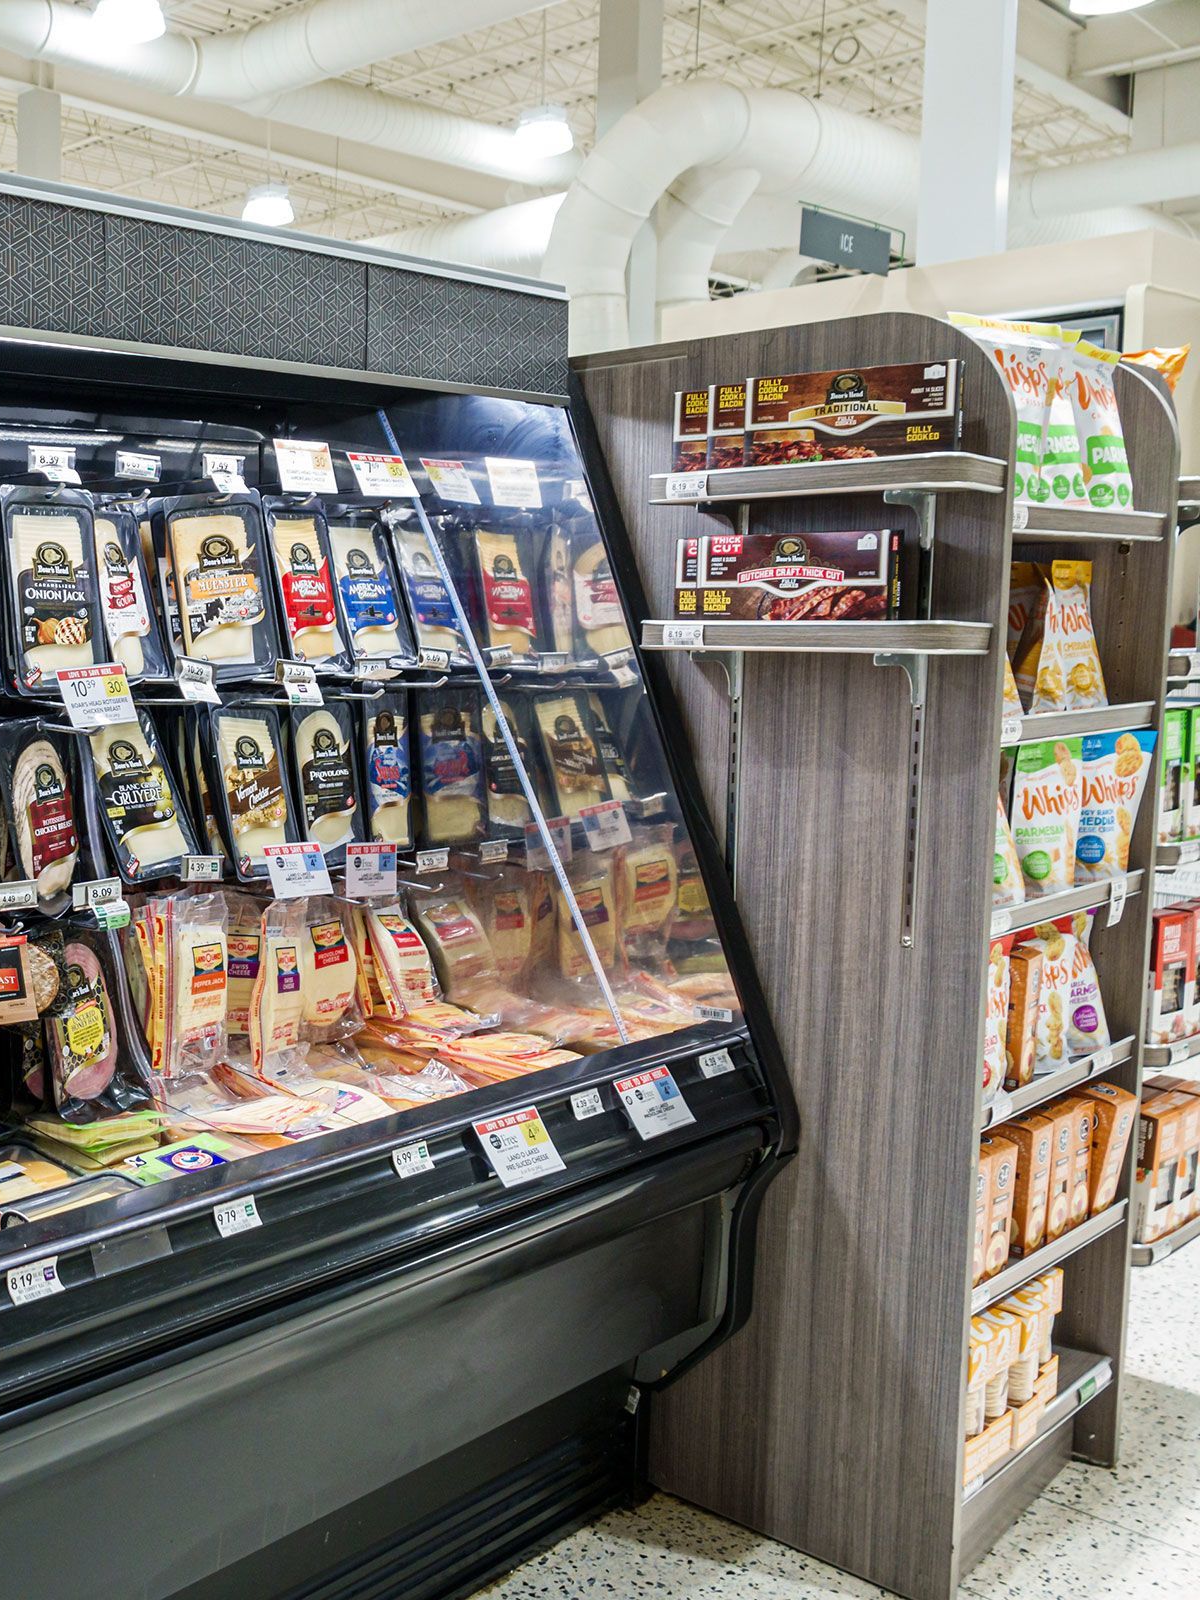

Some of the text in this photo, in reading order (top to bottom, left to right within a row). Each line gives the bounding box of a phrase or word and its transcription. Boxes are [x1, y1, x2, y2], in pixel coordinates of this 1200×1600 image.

[840, 233, 854, 253] ICE
[759, 379, 782, 387] FULLY
[758, 393, 783, 401] BACON
[814, 404, 878, 414] TRADITIONAL
[672, 482, 686, 491] 8.19
[713, 544, 741, 552] CUT
[740, 571, 774, 581] BUTCHER
[801, 569, 824, 578] THICK
[826, 572, 841, 581] CUT
[199, 577, 248, 591] MUENSTER
[291, 581, 326, 596] AMERICAN
[350, 584, 385, 596] AMERICAN
[25, 588, 85, 602] ONION JACK
[112, 786, 162, 802] GRUYERE
[1016, 827, 1064, 837] PARMESAN
[92, 888, 112, 898] 8.09
[195, 977, 224, 989] PEPPER JACK
[506, 1154, 549, 1171] PRE SLICED CHEESE
